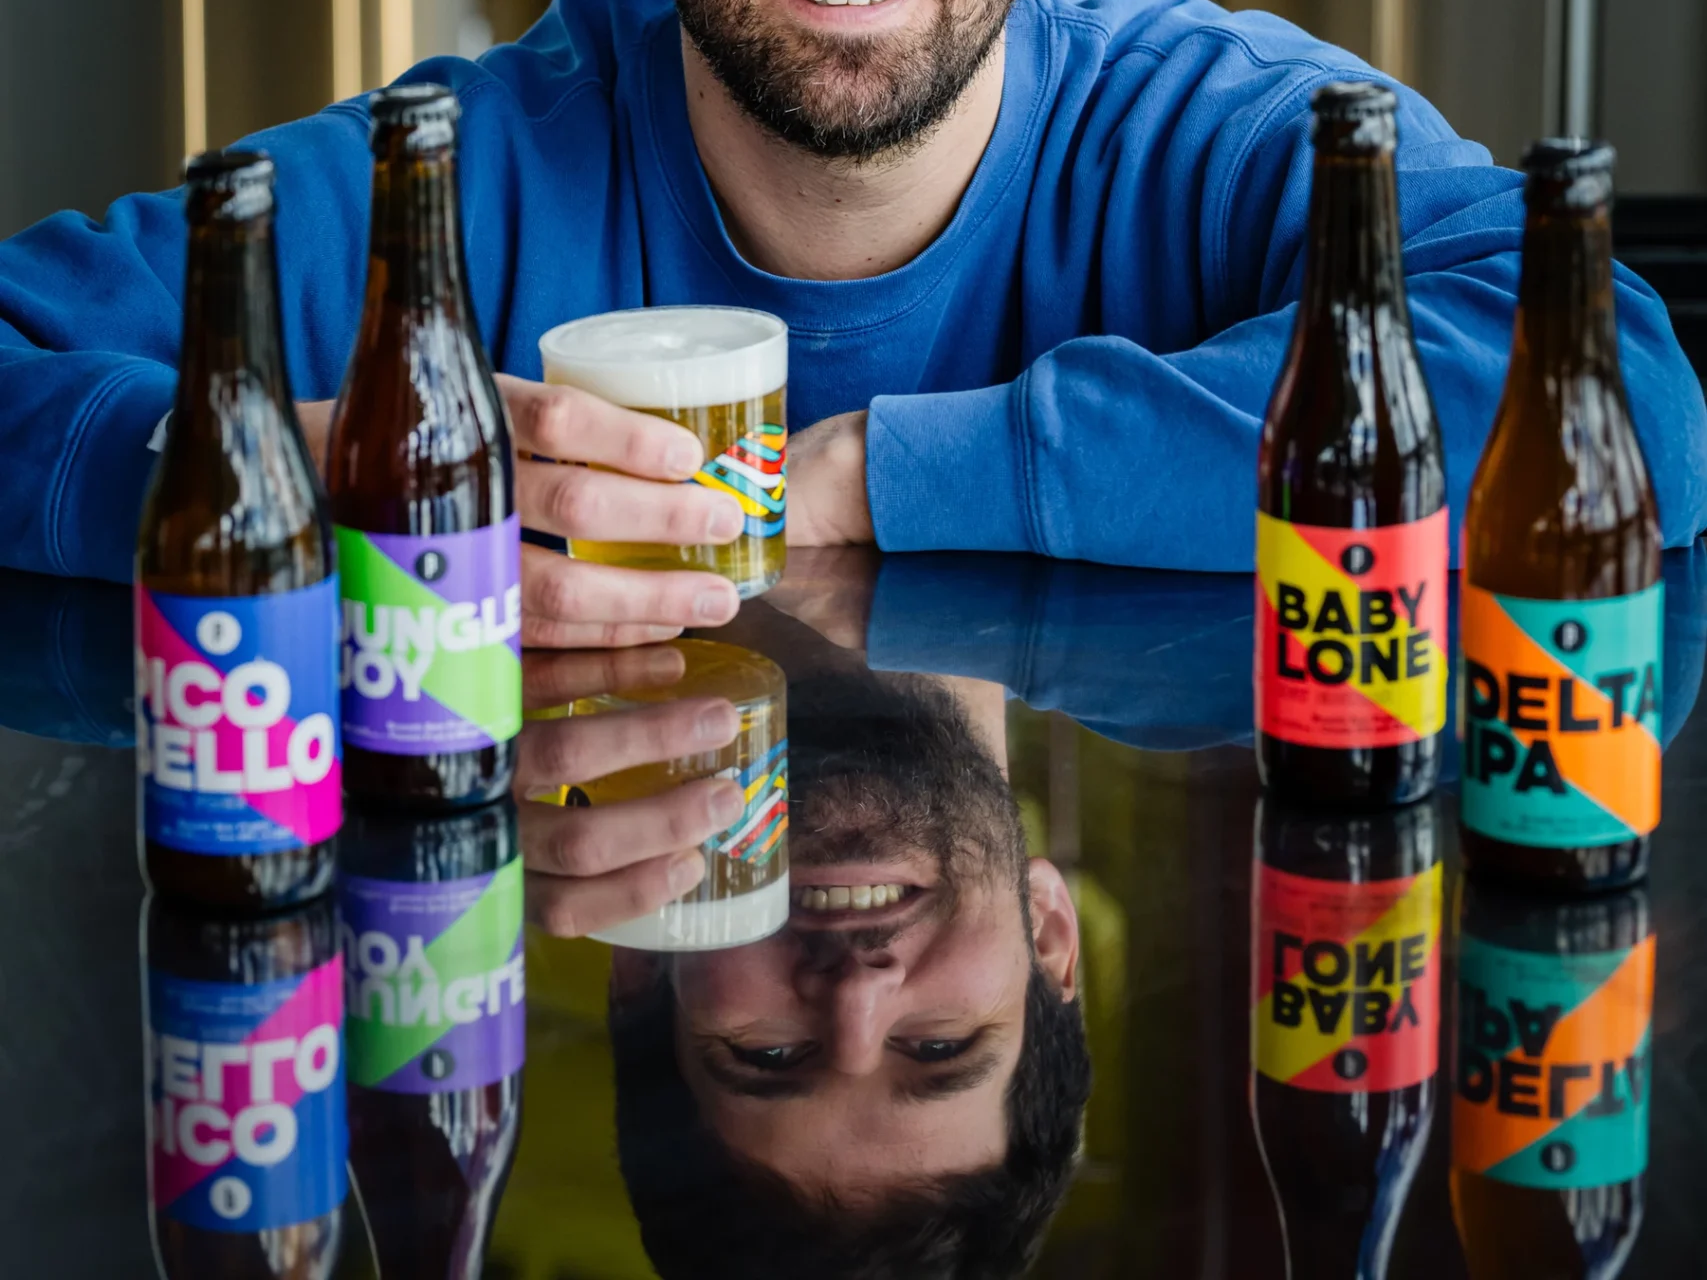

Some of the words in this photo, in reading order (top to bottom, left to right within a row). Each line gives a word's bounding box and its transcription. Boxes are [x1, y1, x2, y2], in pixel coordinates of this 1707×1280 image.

[339, 582, 521, 653] JUNGLE
[1276, 579, 1428, 637] BABY
[338, 644, 436, 702] JOY
[1276, 631, 1431, 686] LONE
[1466, 660, 1657, 733] DELTA
[1467, 720, 1567, 795] IPA
